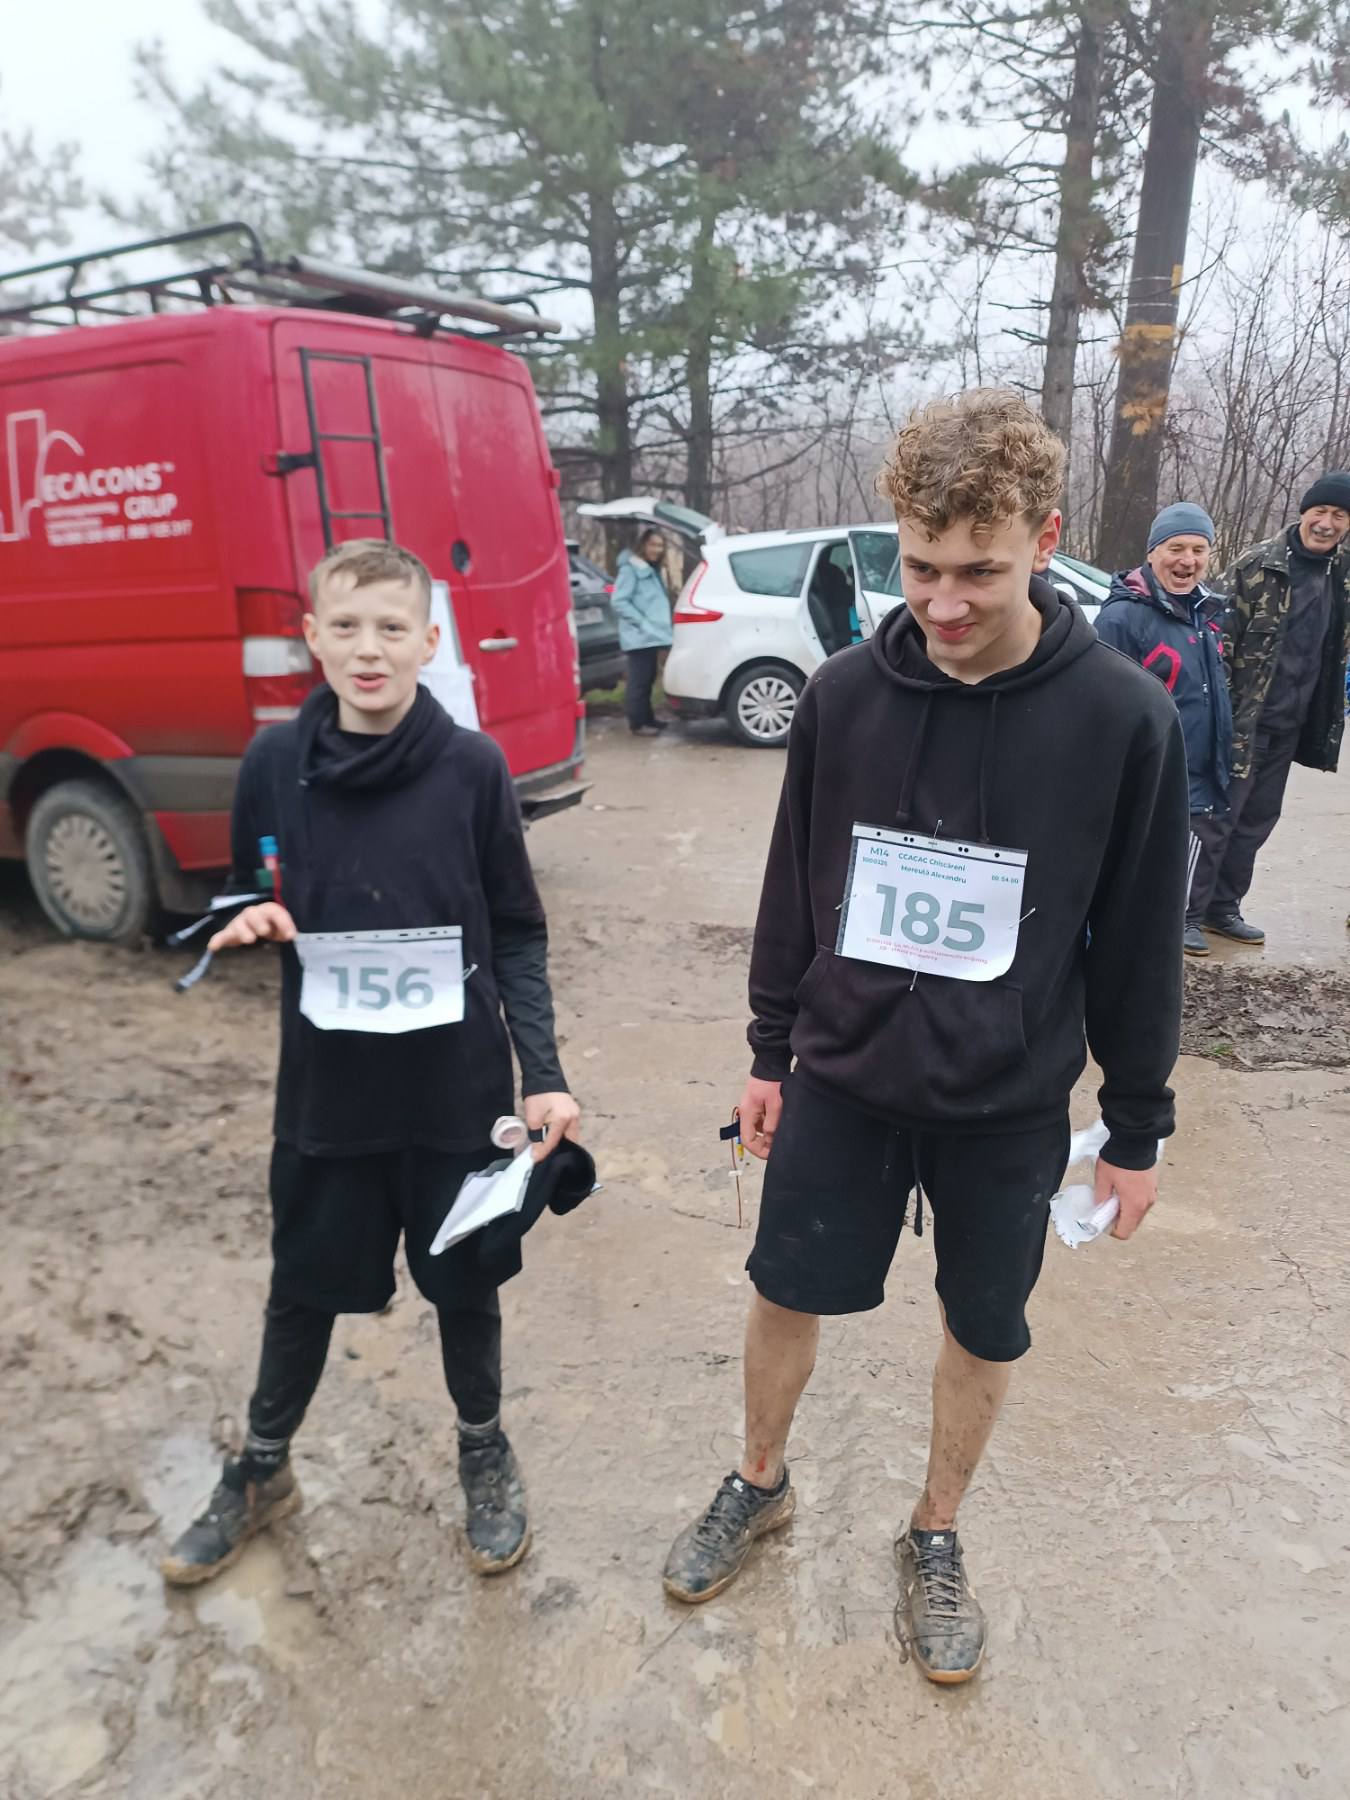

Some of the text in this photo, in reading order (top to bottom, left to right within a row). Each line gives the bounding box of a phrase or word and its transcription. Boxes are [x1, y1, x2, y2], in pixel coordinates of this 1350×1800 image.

[870, 847, 889, 857] M14
[875, 883, 985, 953] 185
[328, 966, 434, 1011] 156
